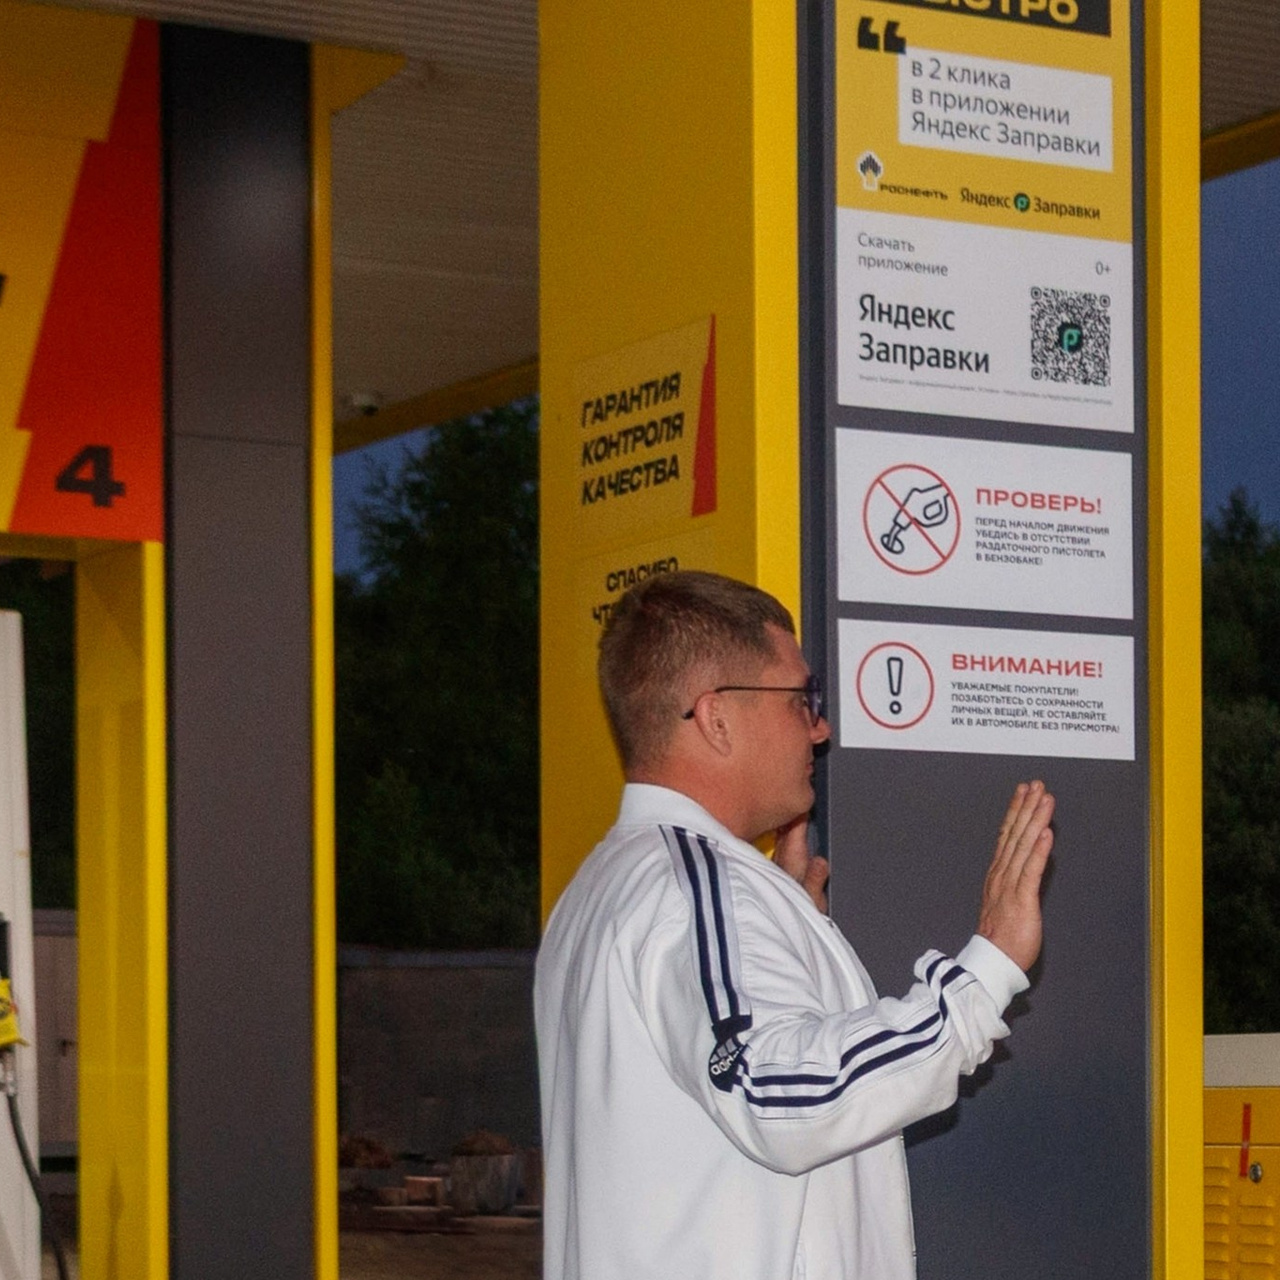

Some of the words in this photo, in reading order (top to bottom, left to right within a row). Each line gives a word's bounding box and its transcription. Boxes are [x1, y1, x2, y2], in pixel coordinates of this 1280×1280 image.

[911, 60, 923, 78] в
[929, 58, 942, 80] 2
[947, 64, 1012, 90] клика
[911, 87, 923, 105] в
[929, 90, 1071, 127] приложении
[911, 111, 991, 142] Яндекс
[997, 123, 1101, 157] Заправки
[879, 183, 949, 201] РОСНЕФТЬ
[960, 187, 1011, 211] Яндекс
[1033, 200, 1101, 221] Заправки
[857, 231, 915, 253] Скачать
[857, 254, 949, 278] приложение
[1095, 261, 1112, 276] 0+
[858, 293, 956, 331] Яндекс
[858, 333, 990, 374] Заправки
[581, 371, 682, 428] ГАРАНТИЯ
[581, 412, 685, 468] КОНТРОЛЯ
[55, 445, 126, 508] 4
[581, 454, 681, 505] КАЧЕСТВА
[975, 487, 1102, 515] ПРОВЕРЬ!
[975, 517, 1007, 528] ПЕРЕД
[1009, 520, 1054, 531] НАЧАЛОМ
[1057, 524, 1110, 535] ДВИЖЕНИЯ
[975, 529, 1020, 540] УБЕДИСЬ
[1030, 533, 1091, 545] ОТСУТСТВИИ
[975, 541, 1050, 554] РАЗДАТОЧНОГО
[1052, 547, 1106, 558] ПИСТОЛЕТА
[951, 653, 1104, 679] ВНИМАНИЕ!
[951, 682, 1011, 693] УВАЖАЕМЫЕ
[951, 694, 1025, 706] ПОЗАБОТЬТЕСЬ
[1035, 698, 1104, 709] СОХРАННОСТИ
[951, 705, 992, 716] ЛИЧНЫХ
[1033, 710, 1045, 718] НЕ
[1047, 710, 1106, 721] ОСТАВЛЯЙТЕ
[951, 717, 964, 725] ИХ
[975, 719, 1039, 730] АВТОМОБИЛЕ
[1041, 722, 1059, 731] БЕЗ
